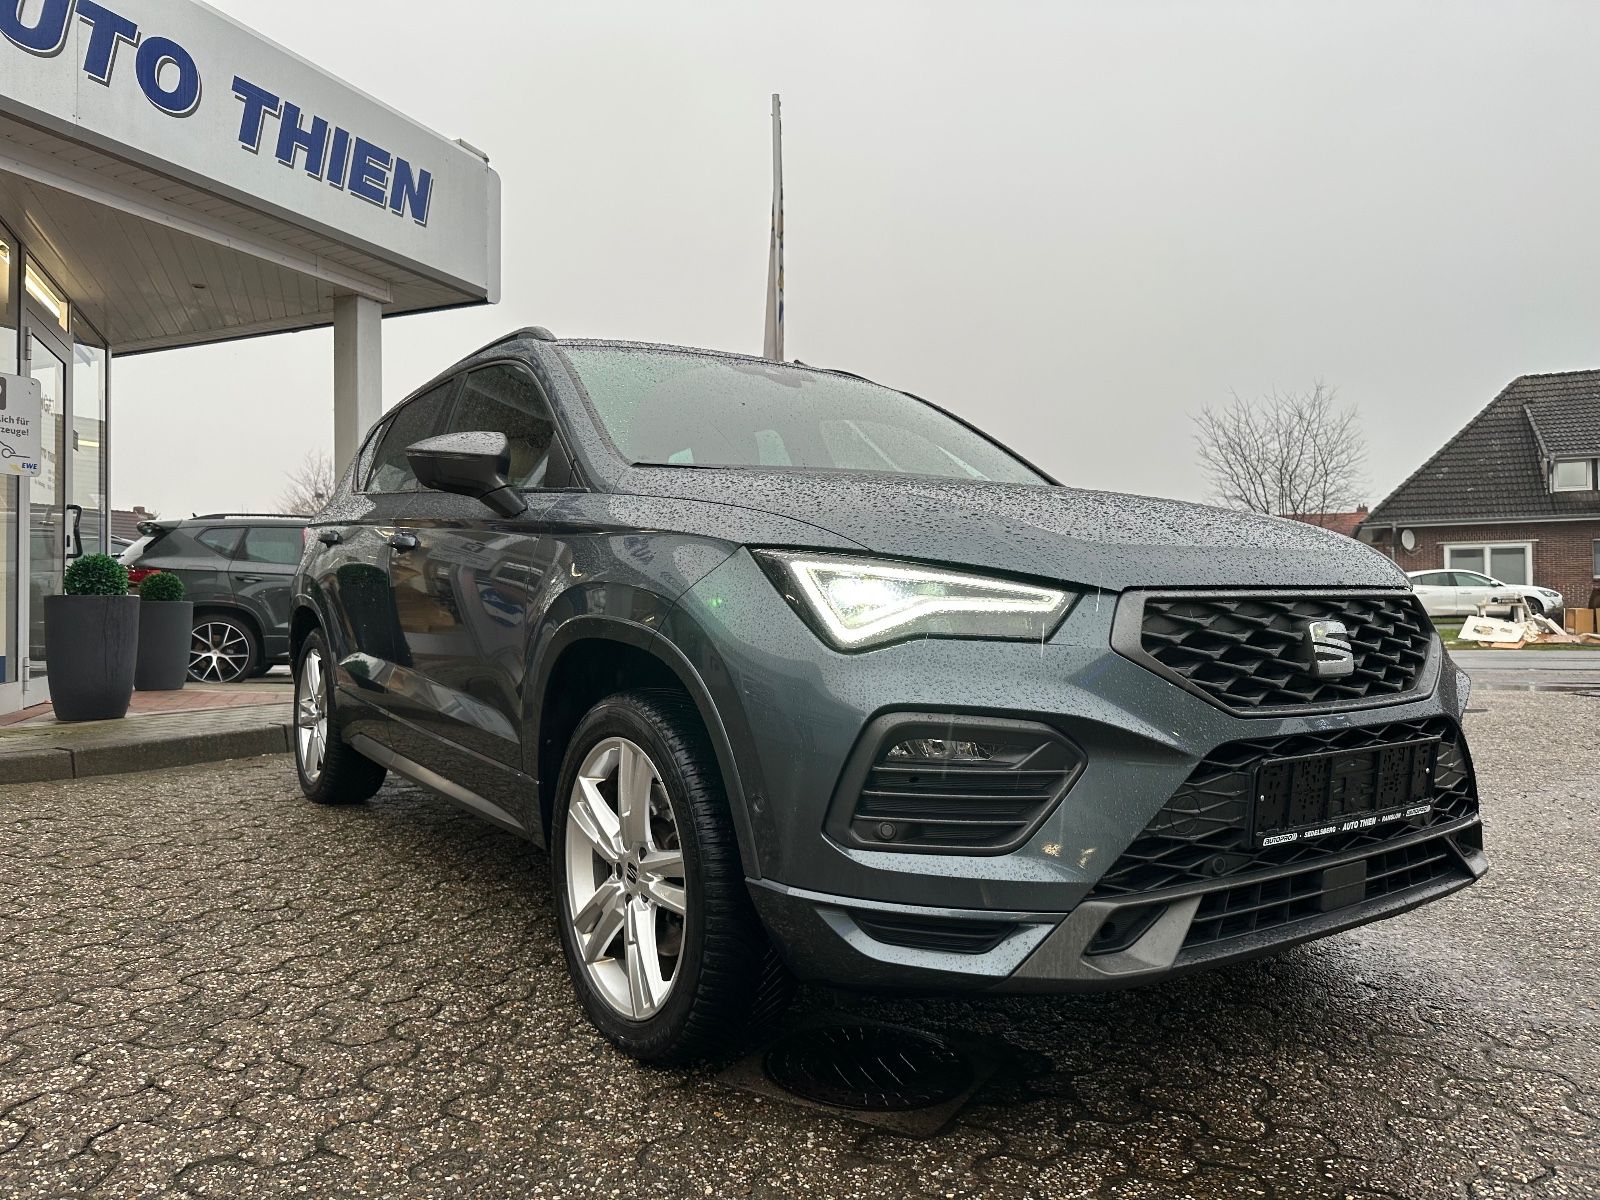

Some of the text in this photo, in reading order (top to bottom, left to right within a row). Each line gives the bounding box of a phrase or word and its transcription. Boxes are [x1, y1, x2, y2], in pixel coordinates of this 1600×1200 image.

[231, 75, 433, 227] THIEN
[0, 415, 30, 426] ich für
[21, 462, 38, 470] EWE
[1341, 820, 1359, 832] AUTO
[1360, 816, 1377, 828] THIEN
